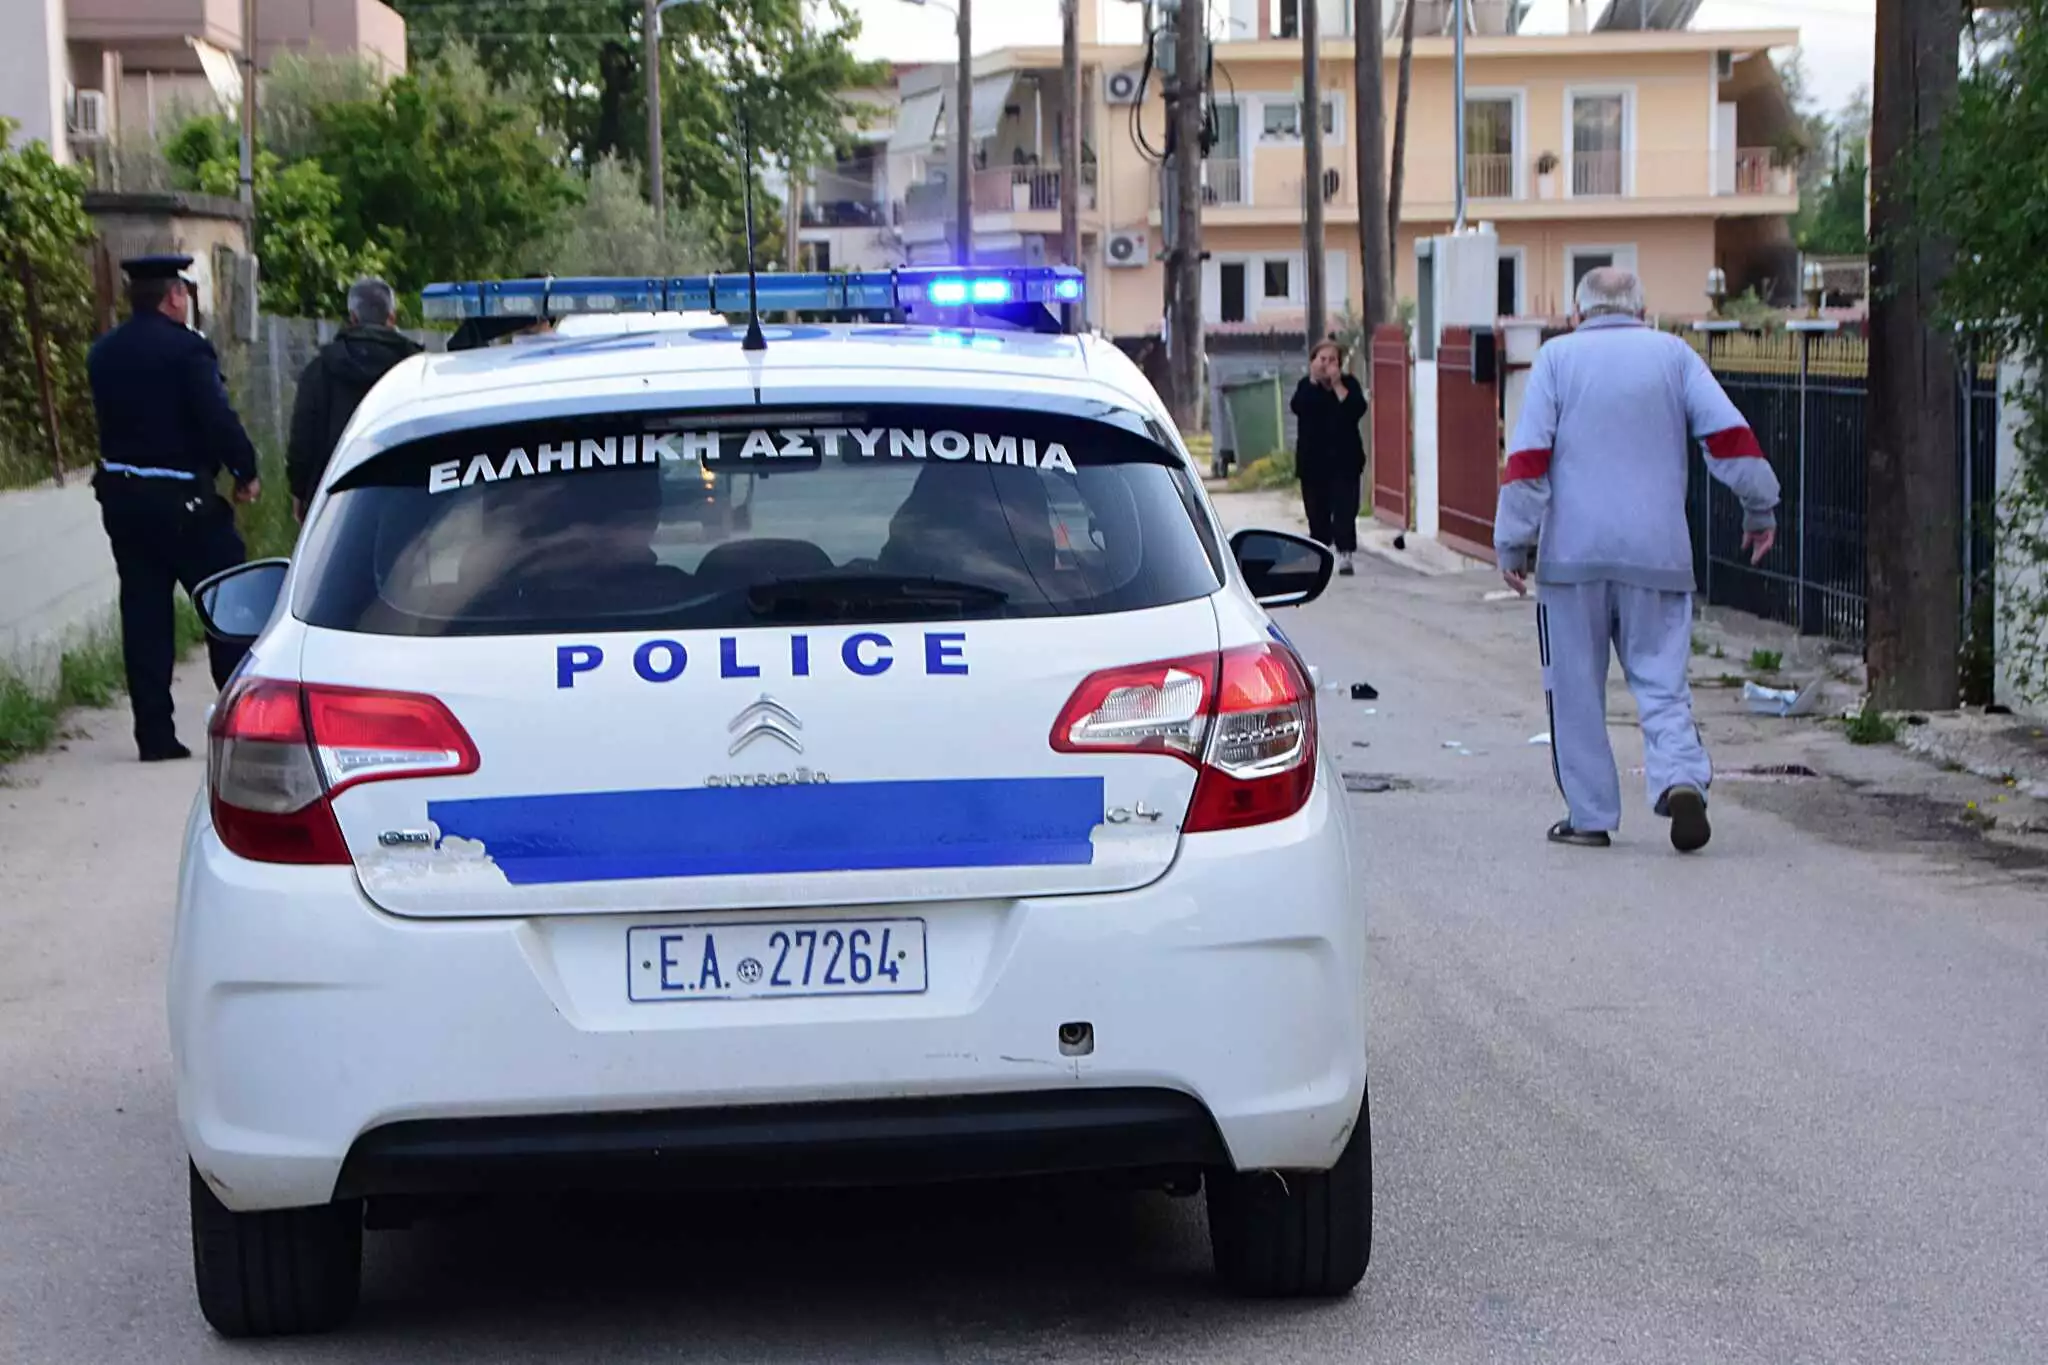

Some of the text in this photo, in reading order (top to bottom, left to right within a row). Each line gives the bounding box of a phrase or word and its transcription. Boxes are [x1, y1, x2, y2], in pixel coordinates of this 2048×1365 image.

[428, 428, 1078, 494] ΕΛΛΗΝΙΚΗ ΑΣΤΥΝΟΜΙΑ
[556, 632, 969, 688] POLICE
[768, 928, 899, 986] 27264
